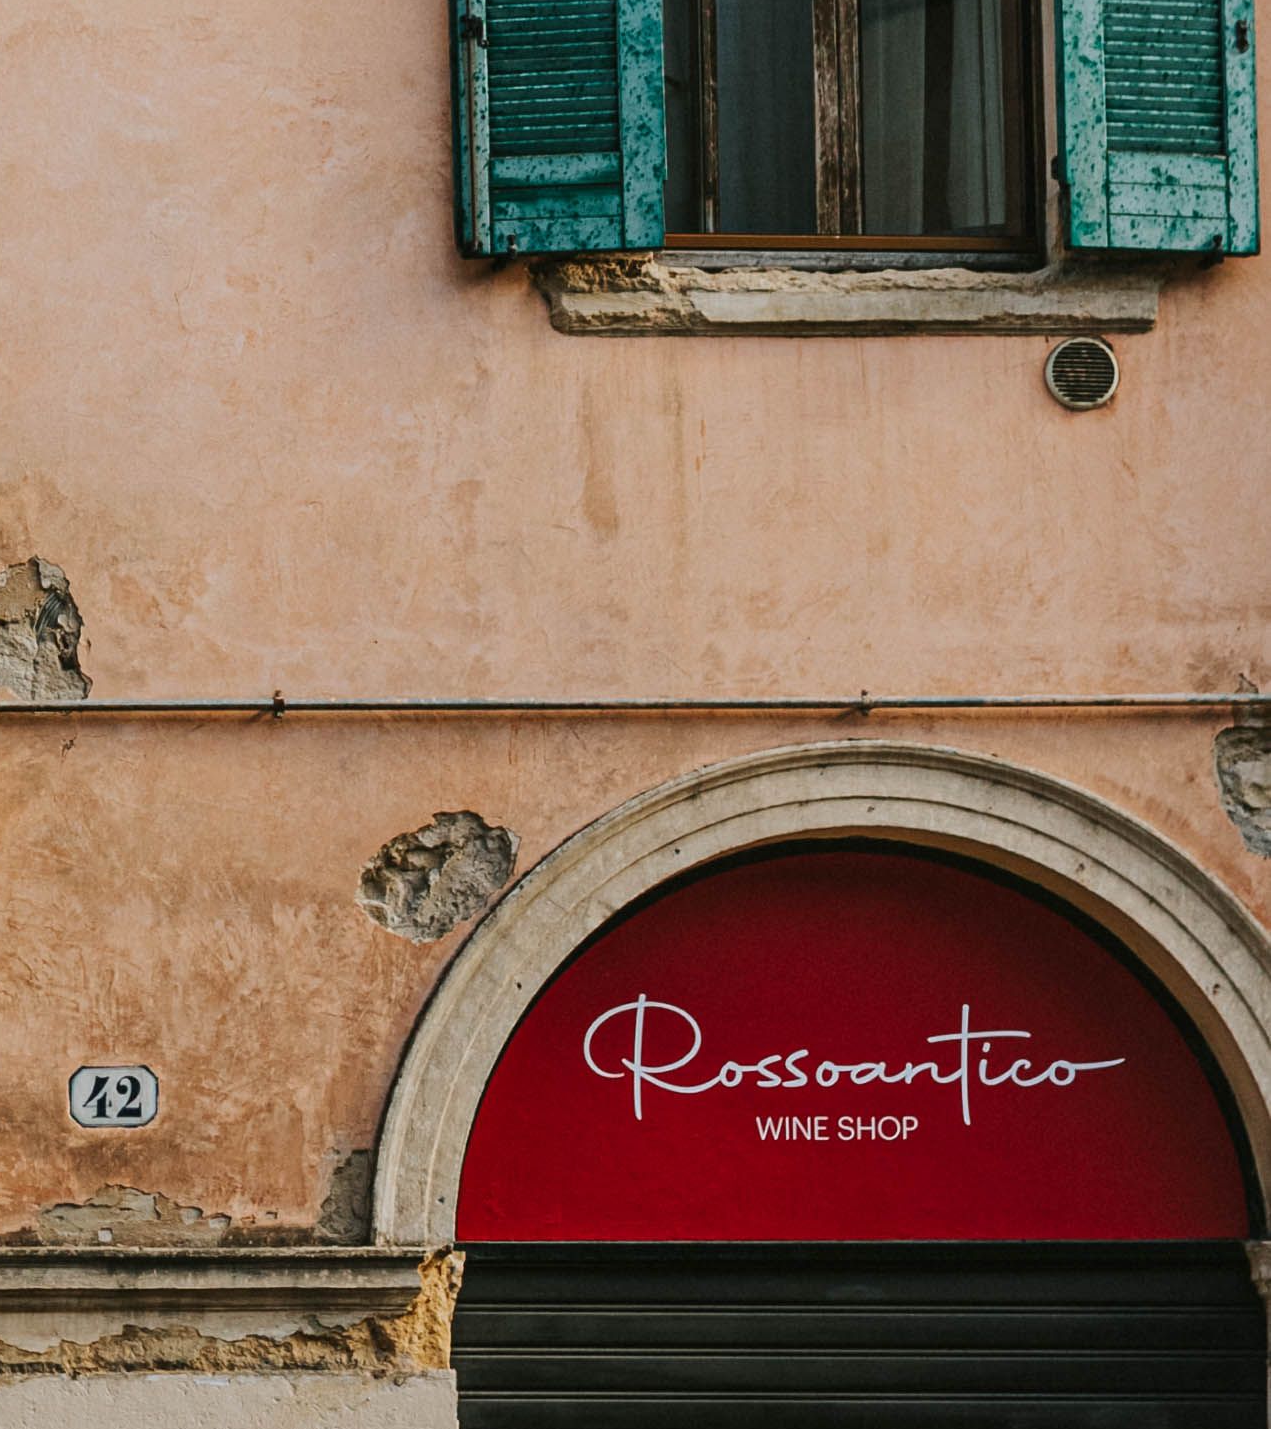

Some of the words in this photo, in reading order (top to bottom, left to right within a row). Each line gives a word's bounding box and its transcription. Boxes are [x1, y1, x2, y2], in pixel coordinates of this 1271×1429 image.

[582, 992, 1126, 1126] Rossoantico
[82, 1075, 142, 1119] 42
[755, 1116, 829, 1141] WINE
[837, 1116, 919, 1141] SHOP
